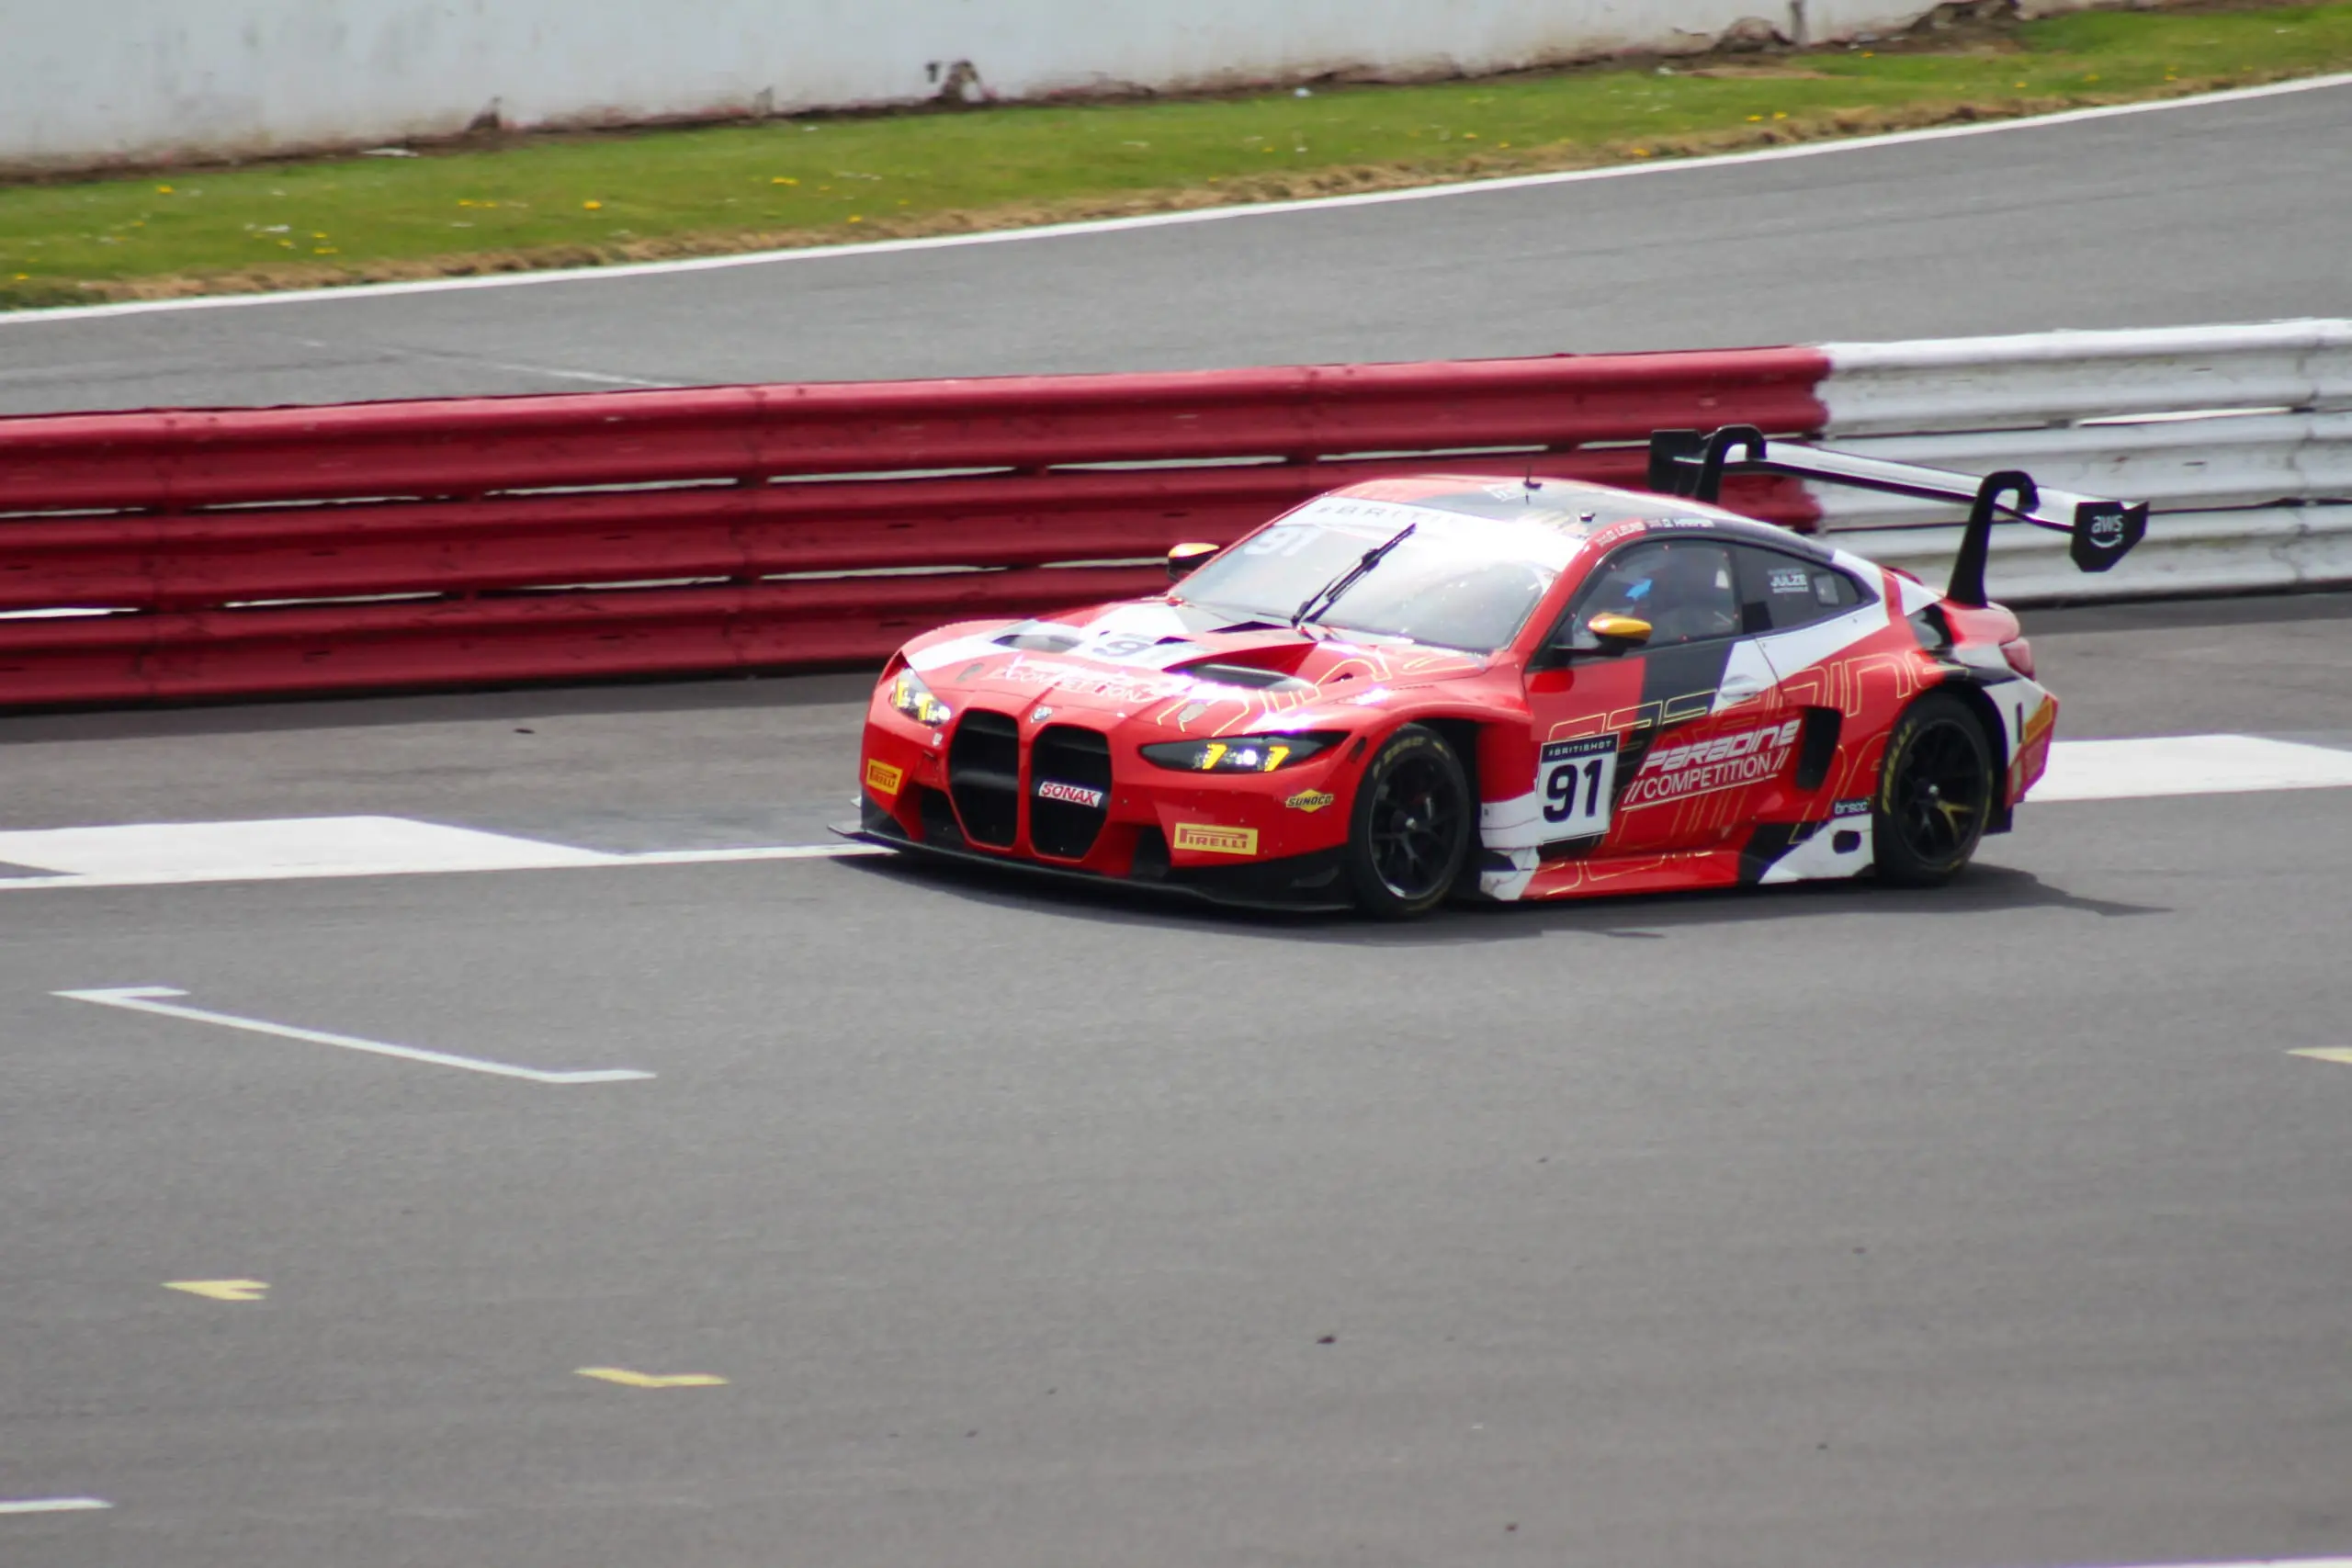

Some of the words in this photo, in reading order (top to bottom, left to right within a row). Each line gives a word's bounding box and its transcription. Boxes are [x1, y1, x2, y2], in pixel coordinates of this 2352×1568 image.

[2091, 514, 2123, 534] aws
[1042, 784, 1096, 807] SONAX
[1287, 795, 1333, 807] SUNOCO
[1543, 759, 1603, 823] 91
[1179, 829, 1249, 849] PIRELLI
